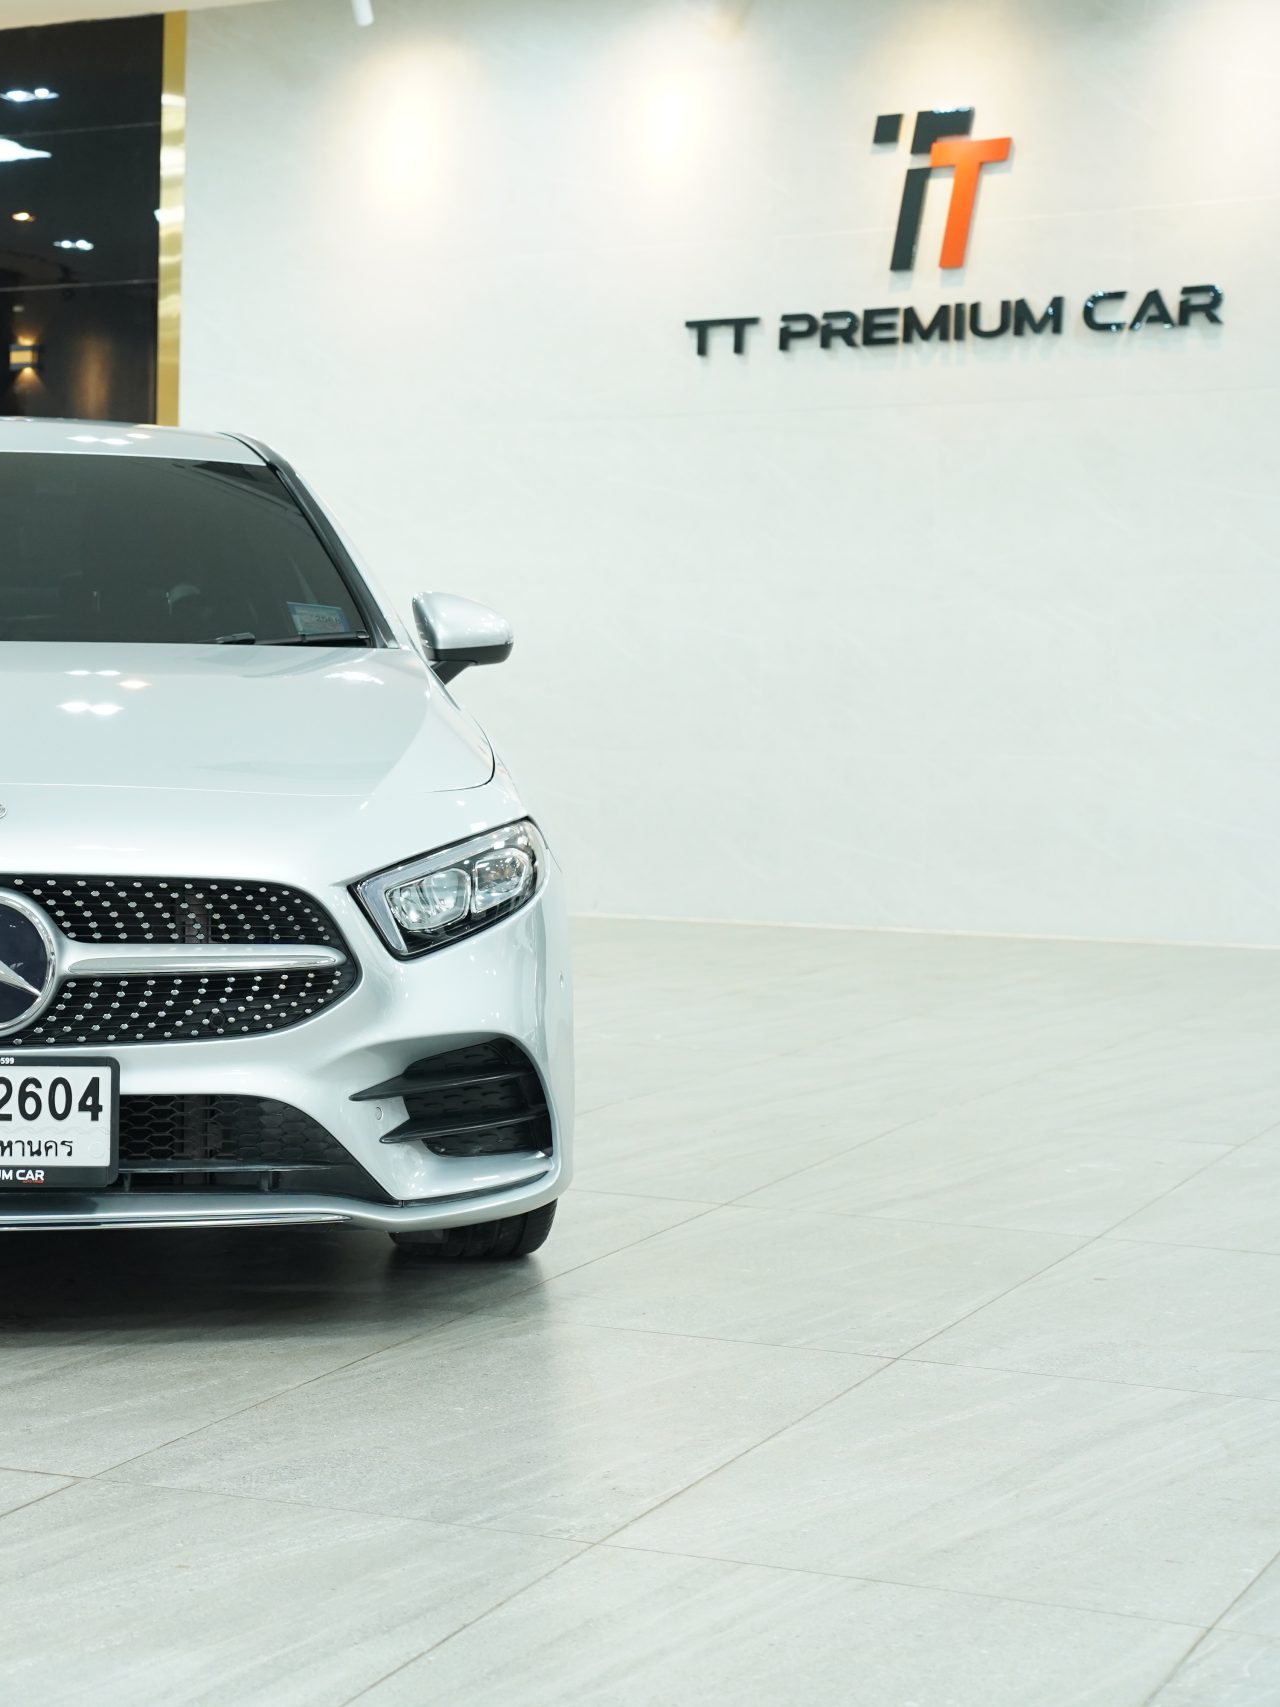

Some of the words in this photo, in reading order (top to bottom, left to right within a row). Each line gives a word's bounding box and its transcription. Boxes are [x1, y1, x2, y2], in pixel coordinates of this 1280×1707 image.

[685, 316, 760, 356] TT
[778, 296, 1063, 352] PREMIUM
[1083, 284, 1224, 333] CAR
[16, 1169, 45, 1181] CAR
